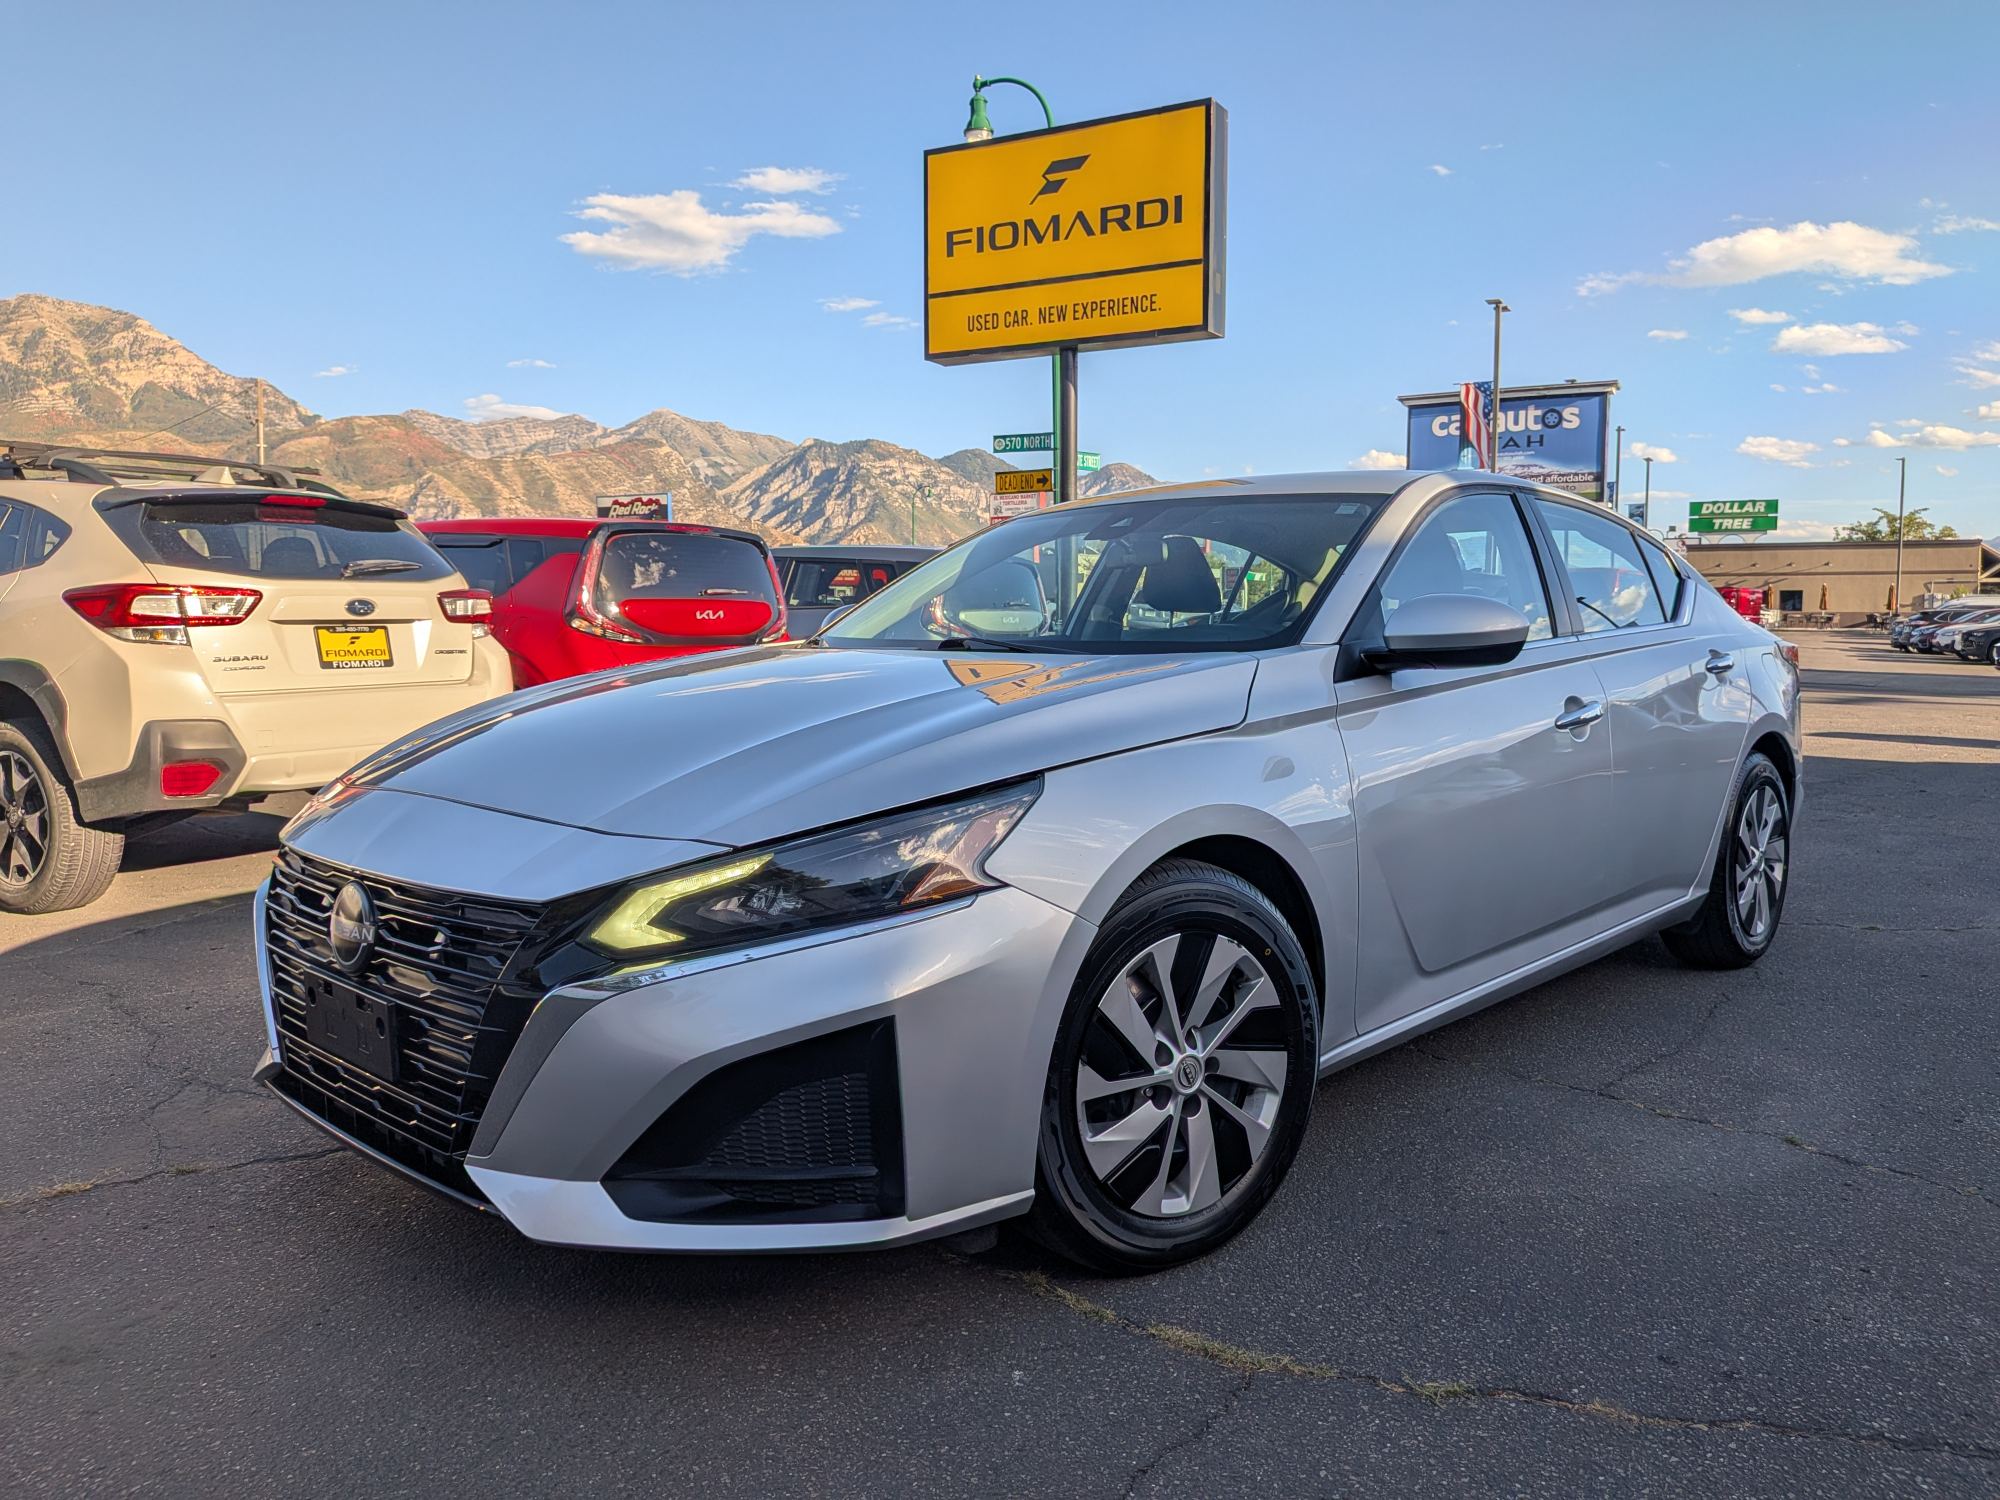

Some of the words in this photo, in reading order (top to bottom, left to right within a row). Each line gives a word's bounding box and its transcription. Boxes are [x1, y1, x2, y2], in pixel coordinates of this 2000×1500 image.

[946, 194, 1183, 258] FIOMARDI
[967, 312, 999, 332] USED
[1004, 308, 1033, 328] CAR.
[1038, 304, 1068, 324] NEW
[1072, 293, 1162, 321] EXPERIENCE.
[1005, 437, 1021, 450] 570
[1023, 435, 1051, 449] NORTH
[999, 475, 1018, 491] DEAD
[1020, 473, 1034, 490] END
[1545, 473, 1595, 483] affordable
[608, 503, 632, 518] Red
[631, 501, 659, 515] Rock
[1701, 501, 1766, 514] DOLLAR
[1713, 518, 1754, 530] TREE
[695, 609, 724, 620] KIA
[325, 648, 387, 658] FIOMARDI
[333, 660, 385, 668] FIOMARDI
